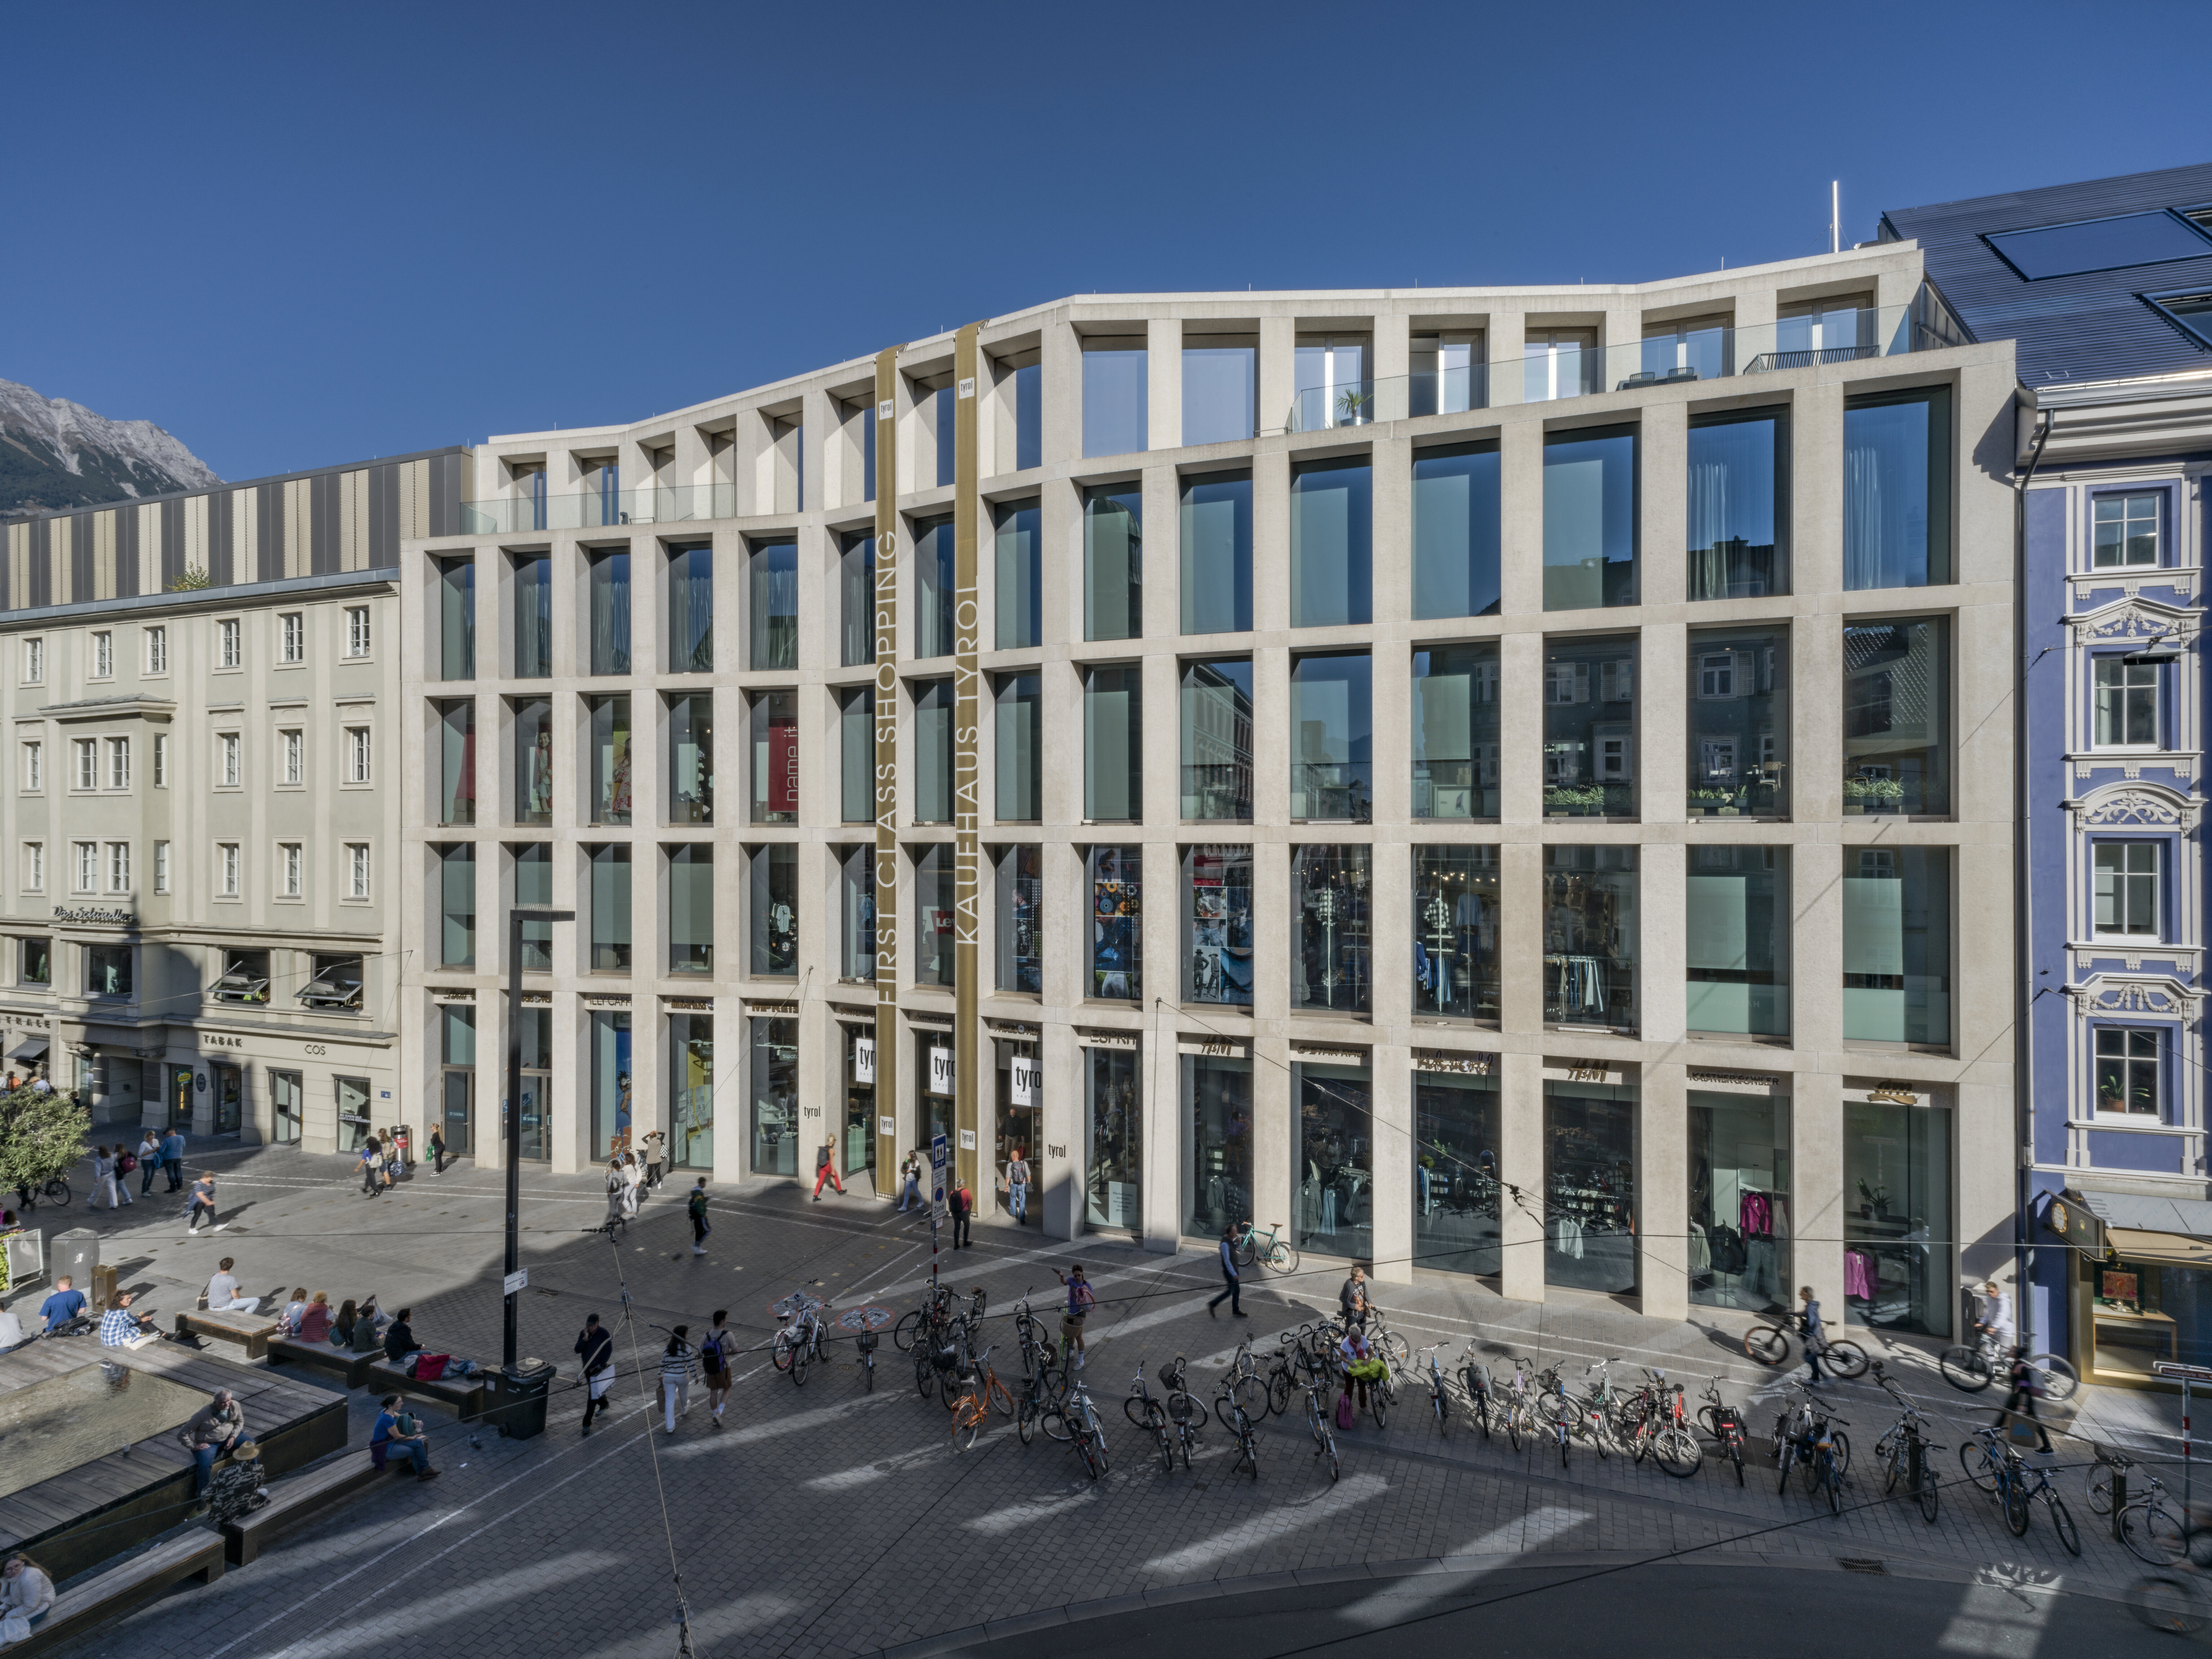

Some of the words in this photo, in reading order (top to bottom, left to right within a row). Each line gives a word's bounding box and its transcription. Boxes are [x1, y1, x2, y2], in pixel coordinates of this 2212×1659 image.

[961, 380, 972, 393] tyrol
[881, 402, 892, 413] tyrol
[876, 531, 896, 743] SHOPPING
[957, 575, 978, 706] TYROL
[784, 727, 798, 737] it
[787, 746, 798, 801] name
[877, 763, 897, 888] CLASS
[957, 726, 978, 944] KAUFHAUS
[52, 905, 73, 918] Das
[73, 907, 133, 920] Schindler
[877, 907, 897, 1005] FIRST
[590, 995, 606, 1006] ILLY
[670, 994, 707, 1010] Timberland
[0, 1016, 51, 1029] TRALE
[203, 1035, 243, 1047] TABAK
[1091, 1029, 1139, 1046] ESPRIT
[1201, 1034, 1234, 1056] H&M
[305, 1044, 326, 1055] COS
[859, 1046, 876, 1070] tyr
[1568, 1058, 1609, 1083] H&M
[1877, 1079, 1913, 1093] dm
[804, 1106, 821, 1119] tyrol
[881, 1119, 893, 1129] tyrol
[962, 1132, 973, 1143] tyrol
[1048, 1143, 1066, 1158] tyrol
[934, 1204, 944, 1214] Zone
